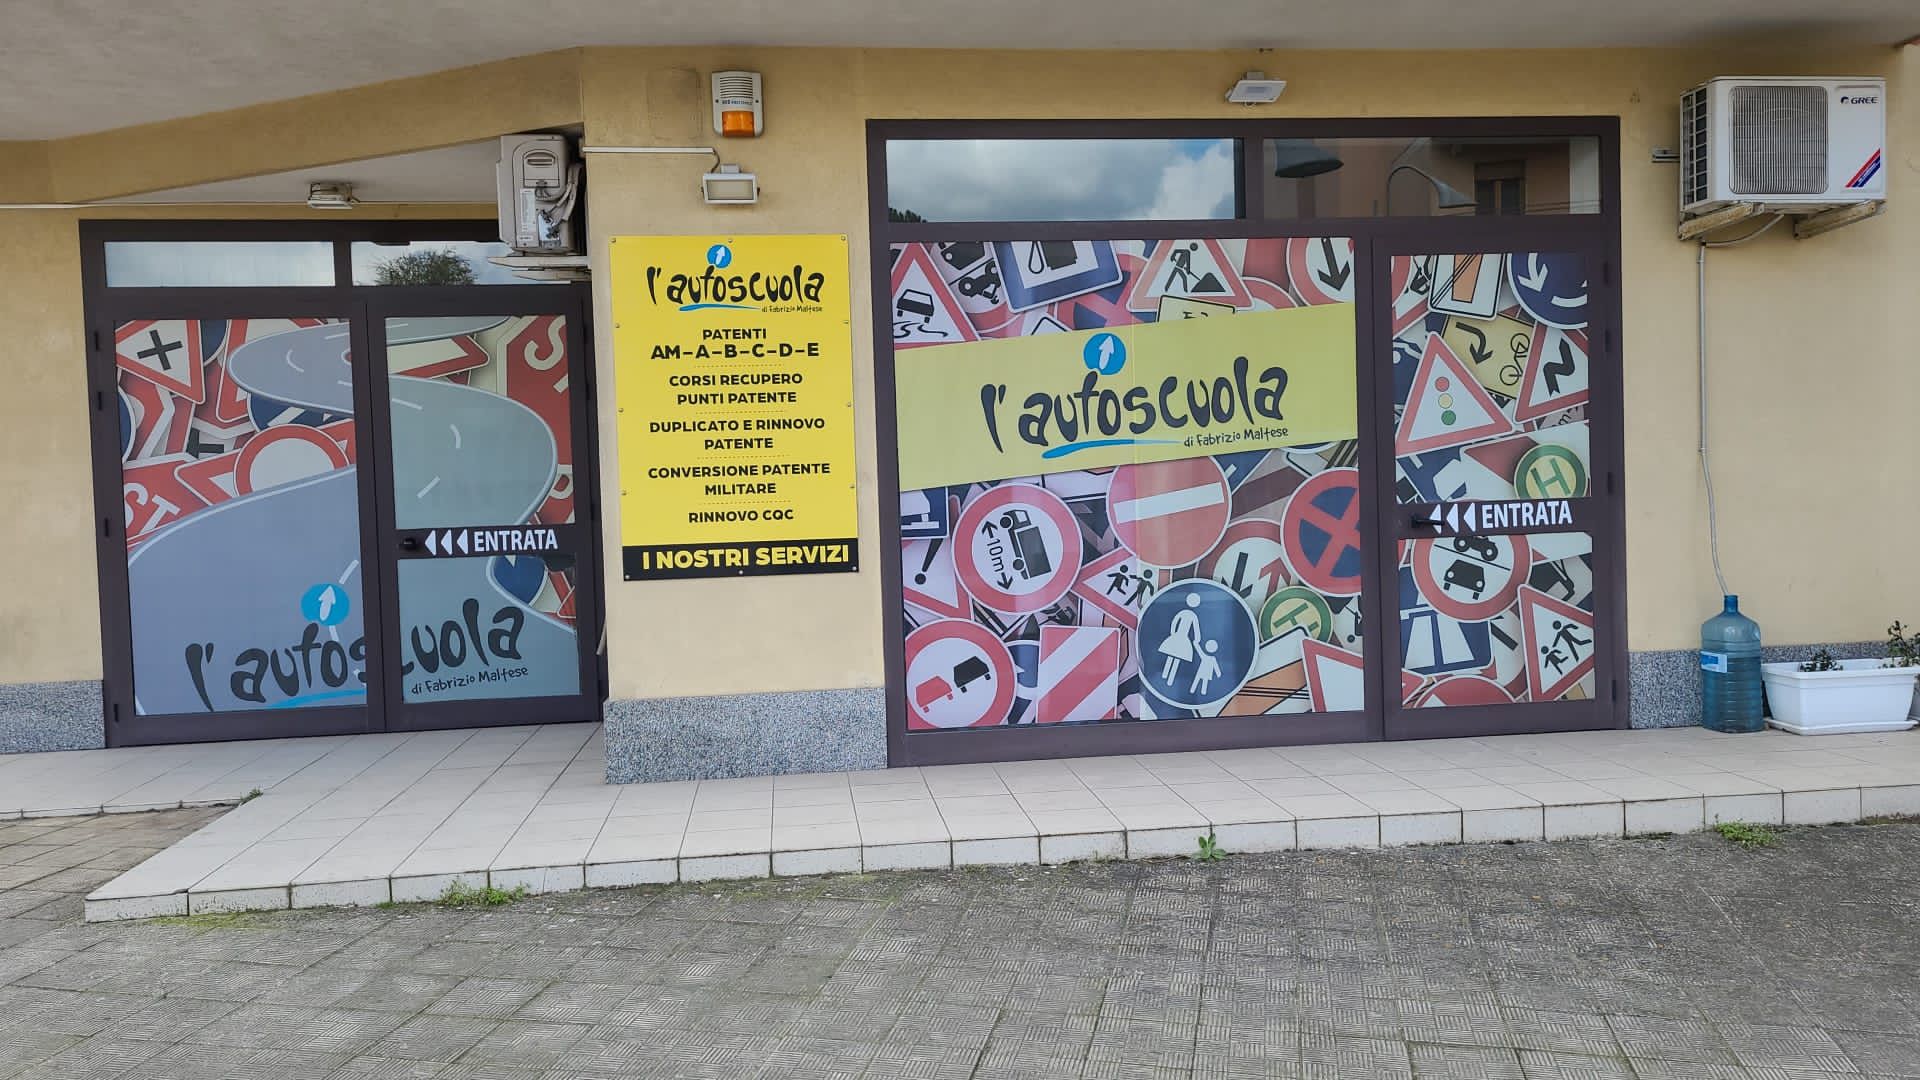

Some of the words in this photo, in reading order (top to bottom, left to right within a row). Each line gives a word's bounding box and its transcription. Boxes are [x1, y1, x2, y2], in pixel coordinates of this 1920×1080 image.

[1851, 96, 1878, 105] GREE
[703, 328, 766, 340] PATENTI
[669, 374, 717, 387] CORSI
[720, 372, 803, 386] RECUPERO
[677, 393, 725, 406] PUNTI
[728, 391, 797, 404] PATENTE
[649, 420, 739, 433] DUPLICATO
[743, 419, 753, 431] E
[756, 418, 826, 431] RINNOVO
[704, 437, 774, 450] PATENTE
[1183, 436, 1195, 448] di
[1196, 431, 1241, 447] Fabrizio
[1243, 425, 1289, 442] Maltese
[648, 465, 759, 479] CONVERSIONE
[762, 463, 831, 476] PATENTE
[704, 482, 777, 496] MILITARE
[688, 510, 759, 523] RINNOVO
[762, 509, 794, 522] CQC
[1481, 500, 1573, 530] ENTRATA
[474, 528, 558, 553] ENTRATA
[642, 551, 650, 570] I
[656, 547, 749, 569] NOSTRI
[755, 544, 850, 566] SERVIZI
[411, 683, 423, 695] di
[425, 675, 476, 692] Fabrizio
[478, 666, 529, 682] Maltese
